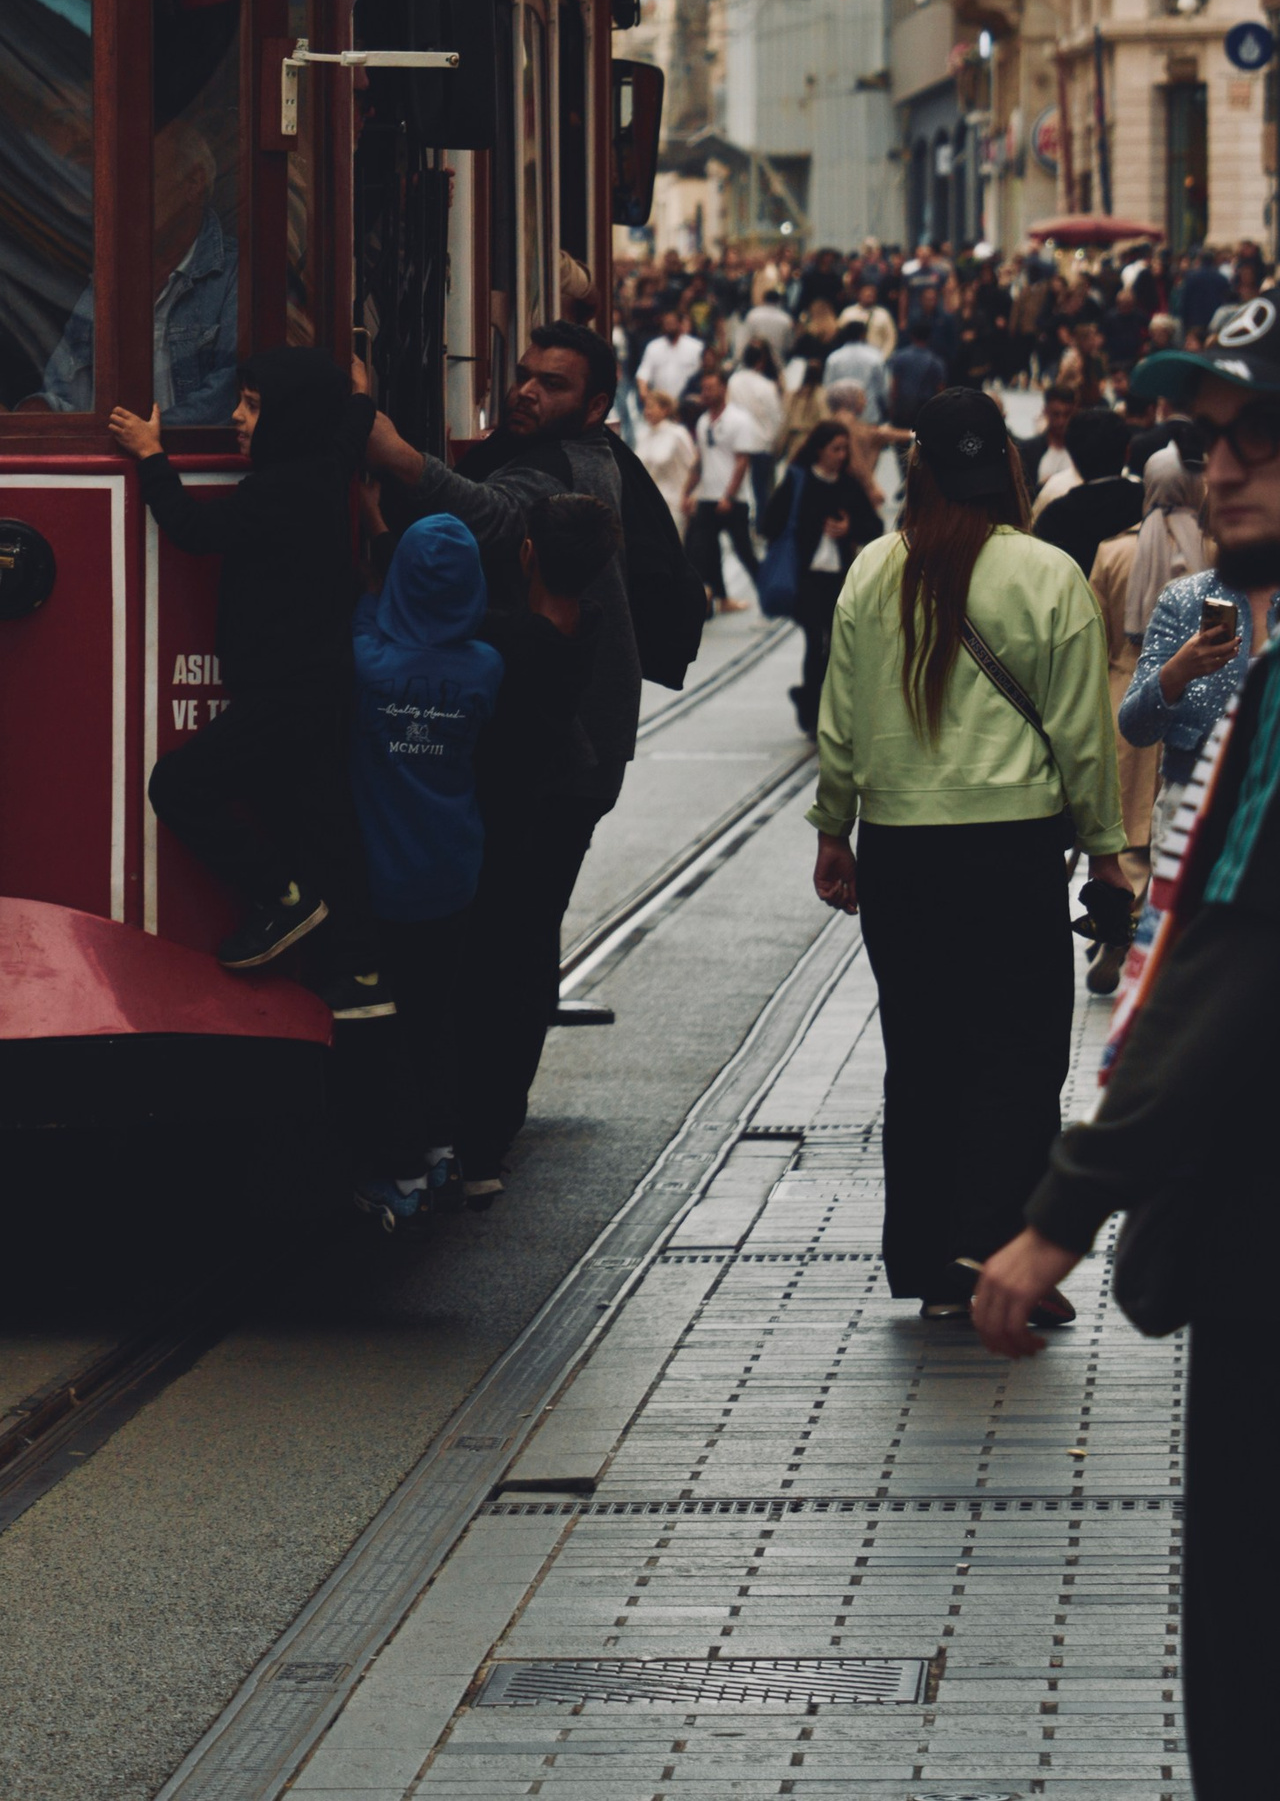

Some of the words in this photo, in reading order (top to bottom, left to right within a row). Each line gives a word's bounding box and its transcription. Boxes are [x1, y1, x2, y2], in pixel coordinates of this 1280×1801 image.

[171, 653, 223, 685] ASIL
[171, 699, 199, 731] VE
[385, 702, 421, 719] Quality
[389, 740, 445, 756] MCMVIII
